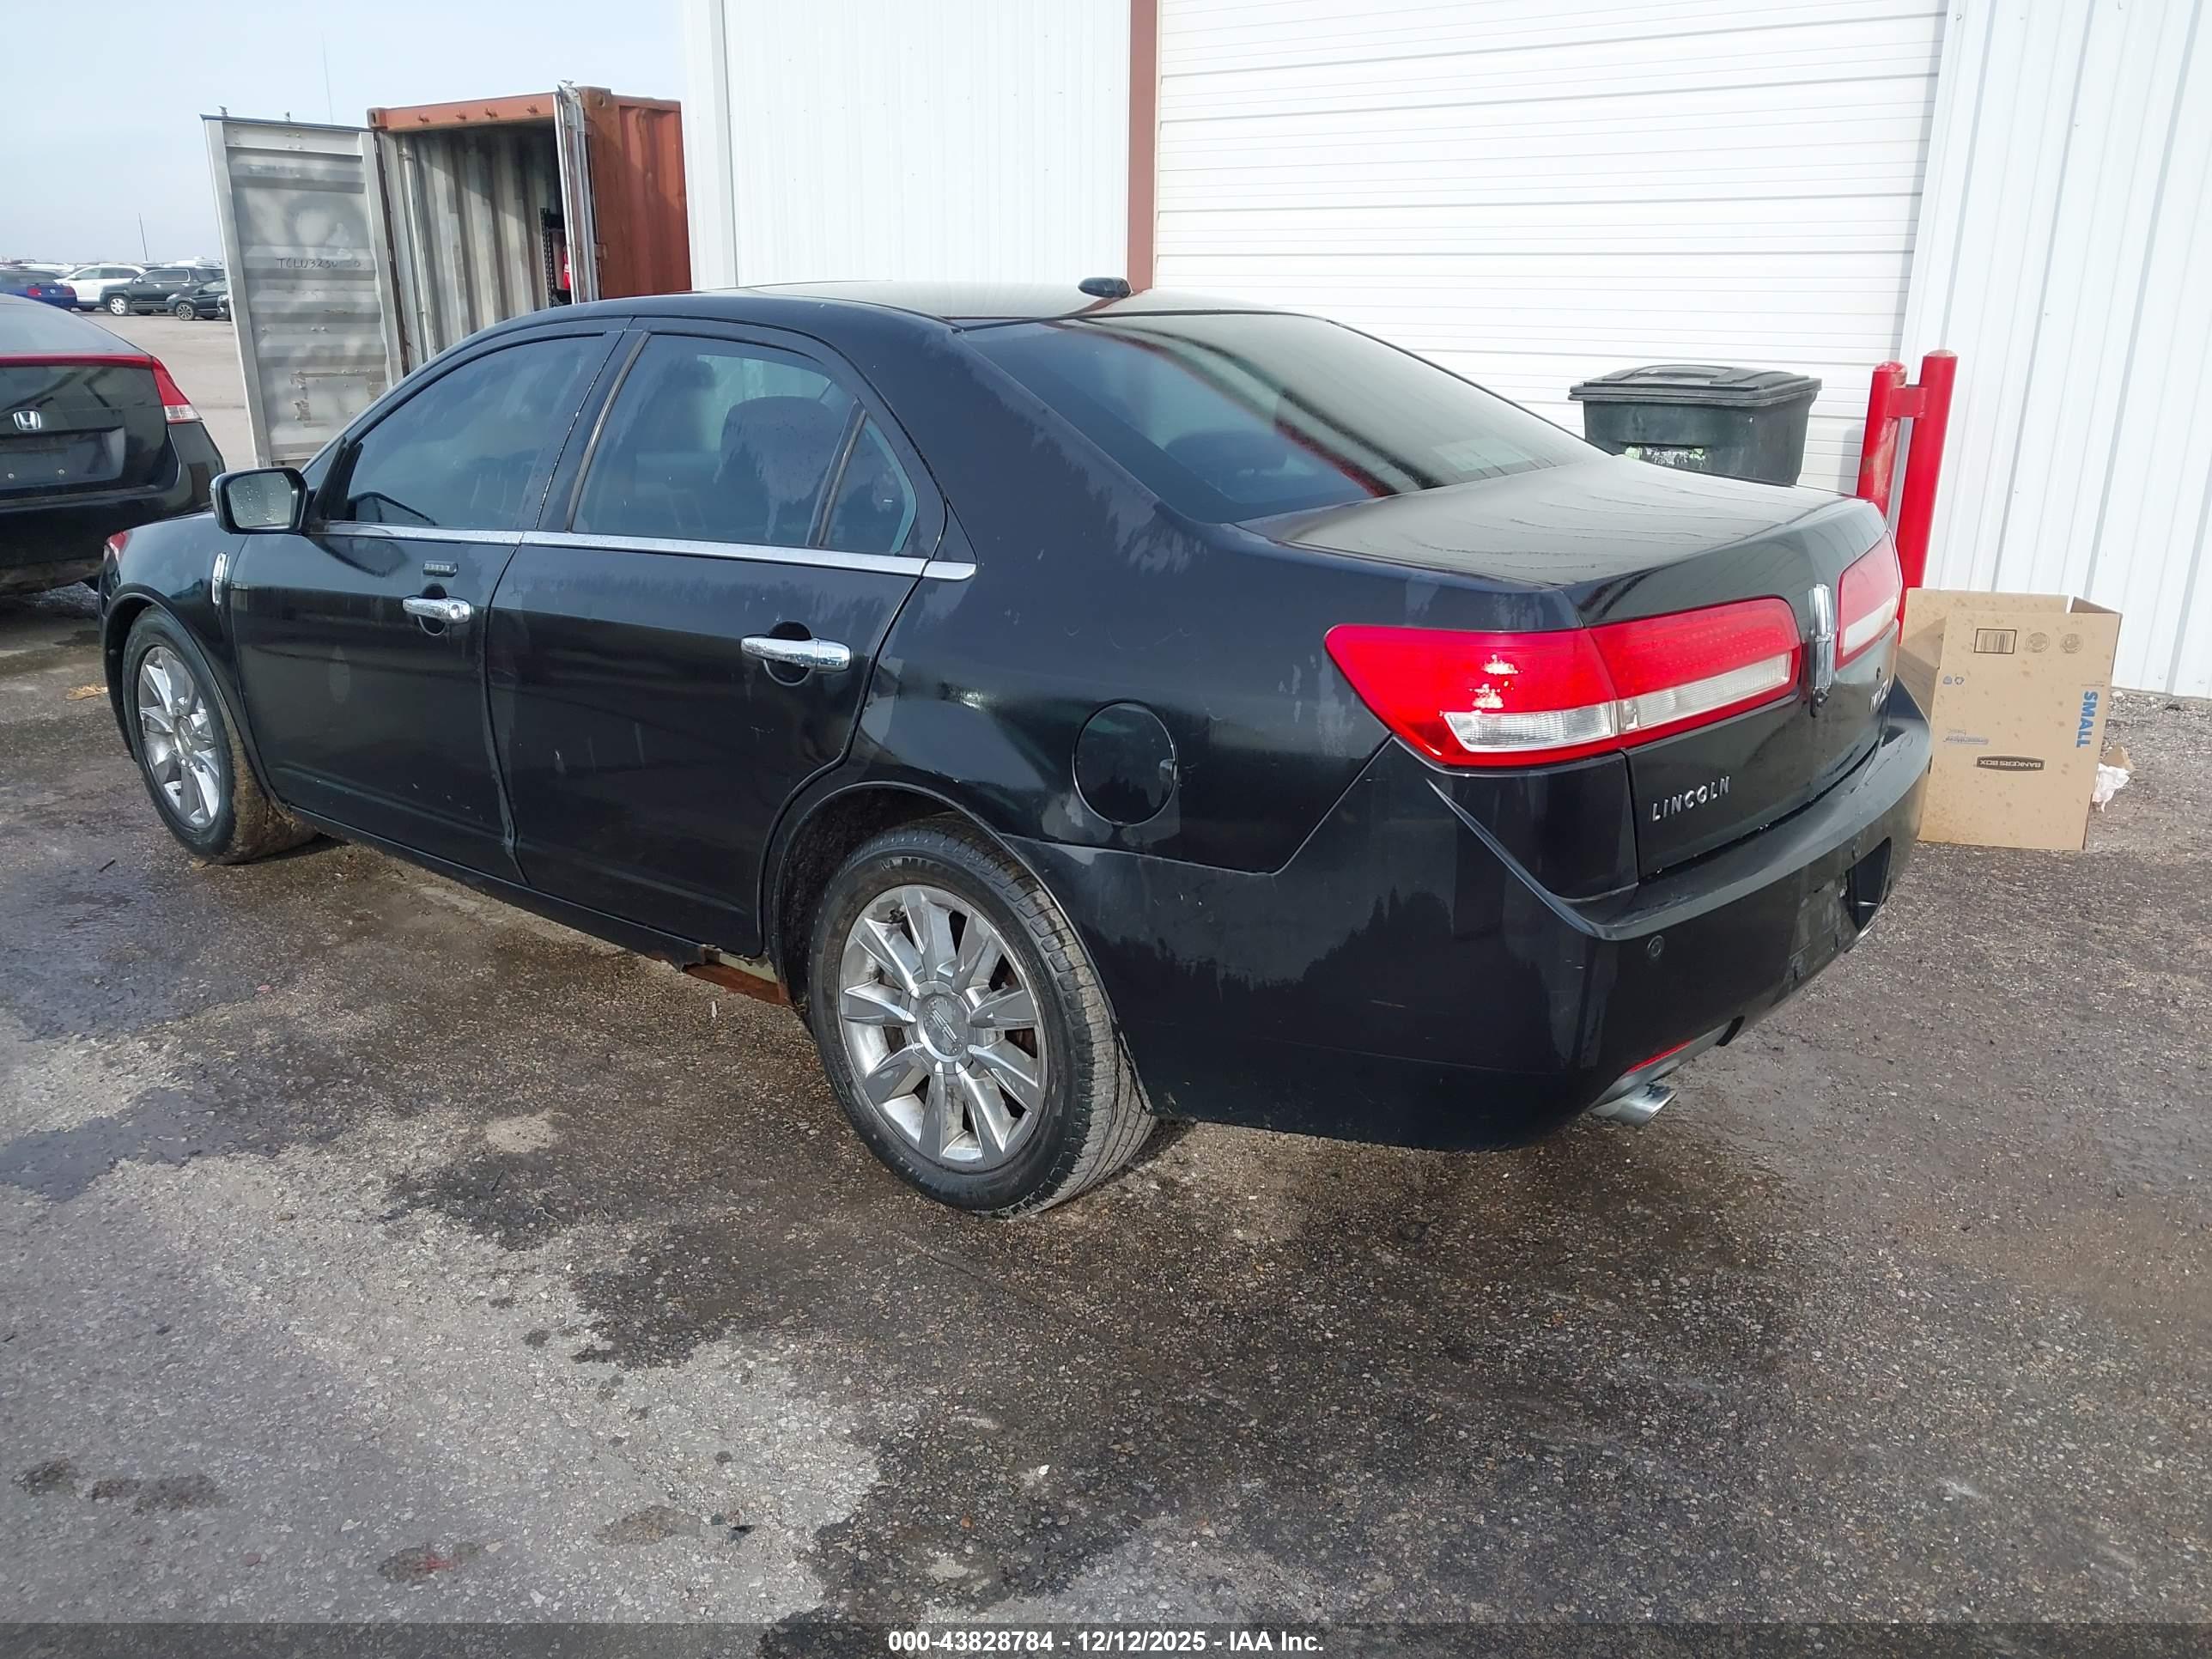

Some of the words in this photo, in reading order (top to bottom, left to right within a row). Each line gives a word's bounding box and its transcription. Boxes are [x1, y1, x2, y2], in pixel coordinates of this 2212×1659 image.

[2075, 690, 2099, 748] SMALL
[1999, 760, 2042, 769] BANKERS
[1652, 775, 1730, 822] LINCOLN
